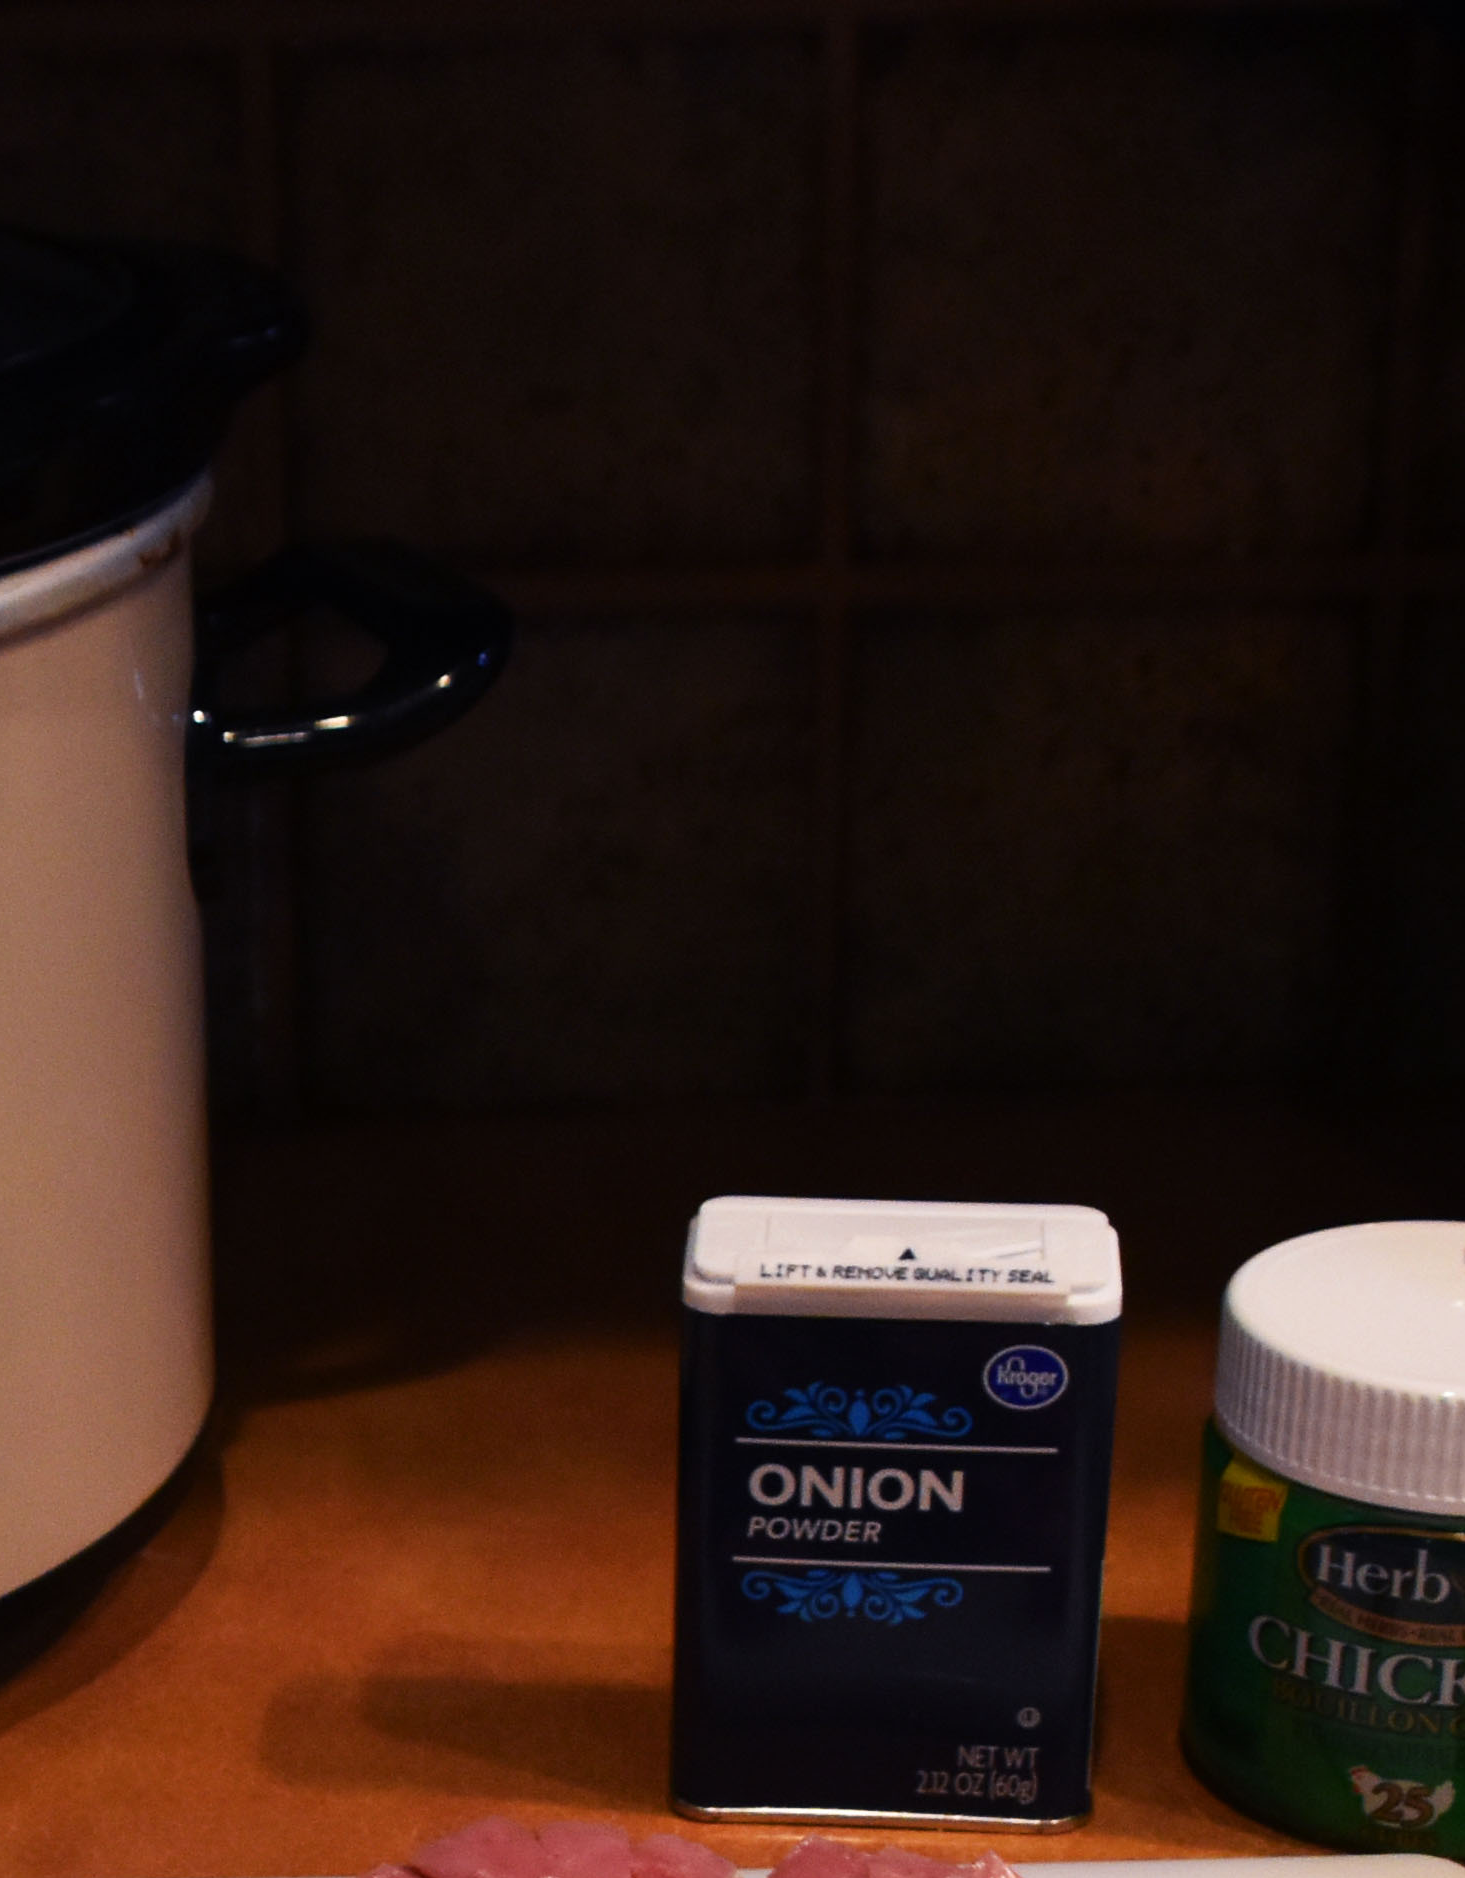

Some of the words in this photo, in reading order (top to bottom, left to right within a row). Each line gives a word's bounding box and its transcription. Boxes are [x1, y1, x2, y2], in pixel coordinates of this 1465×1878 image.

[760, 1263, 811, 1279] LIFT
[832, 1264, 909, 1281] REMOVE
[914, 1266, 1001, 1283] QUALITY
[1006, 1268, 1055, 1285] SEAL
[995, 1356, 1058, 1399] Kroger
[748, 1462, 964, 1514] ONION
[746, 1516, 883, 1544] POWDER
[1316, 1542, 1452, 1605] Herb
[957, 1743, 1000, 1769] NET
[1003, 1745, 1041, 1769] WT
[953, 1771, 986, 1797] OZ
[1371, 1782, 1436, 1829] 25
